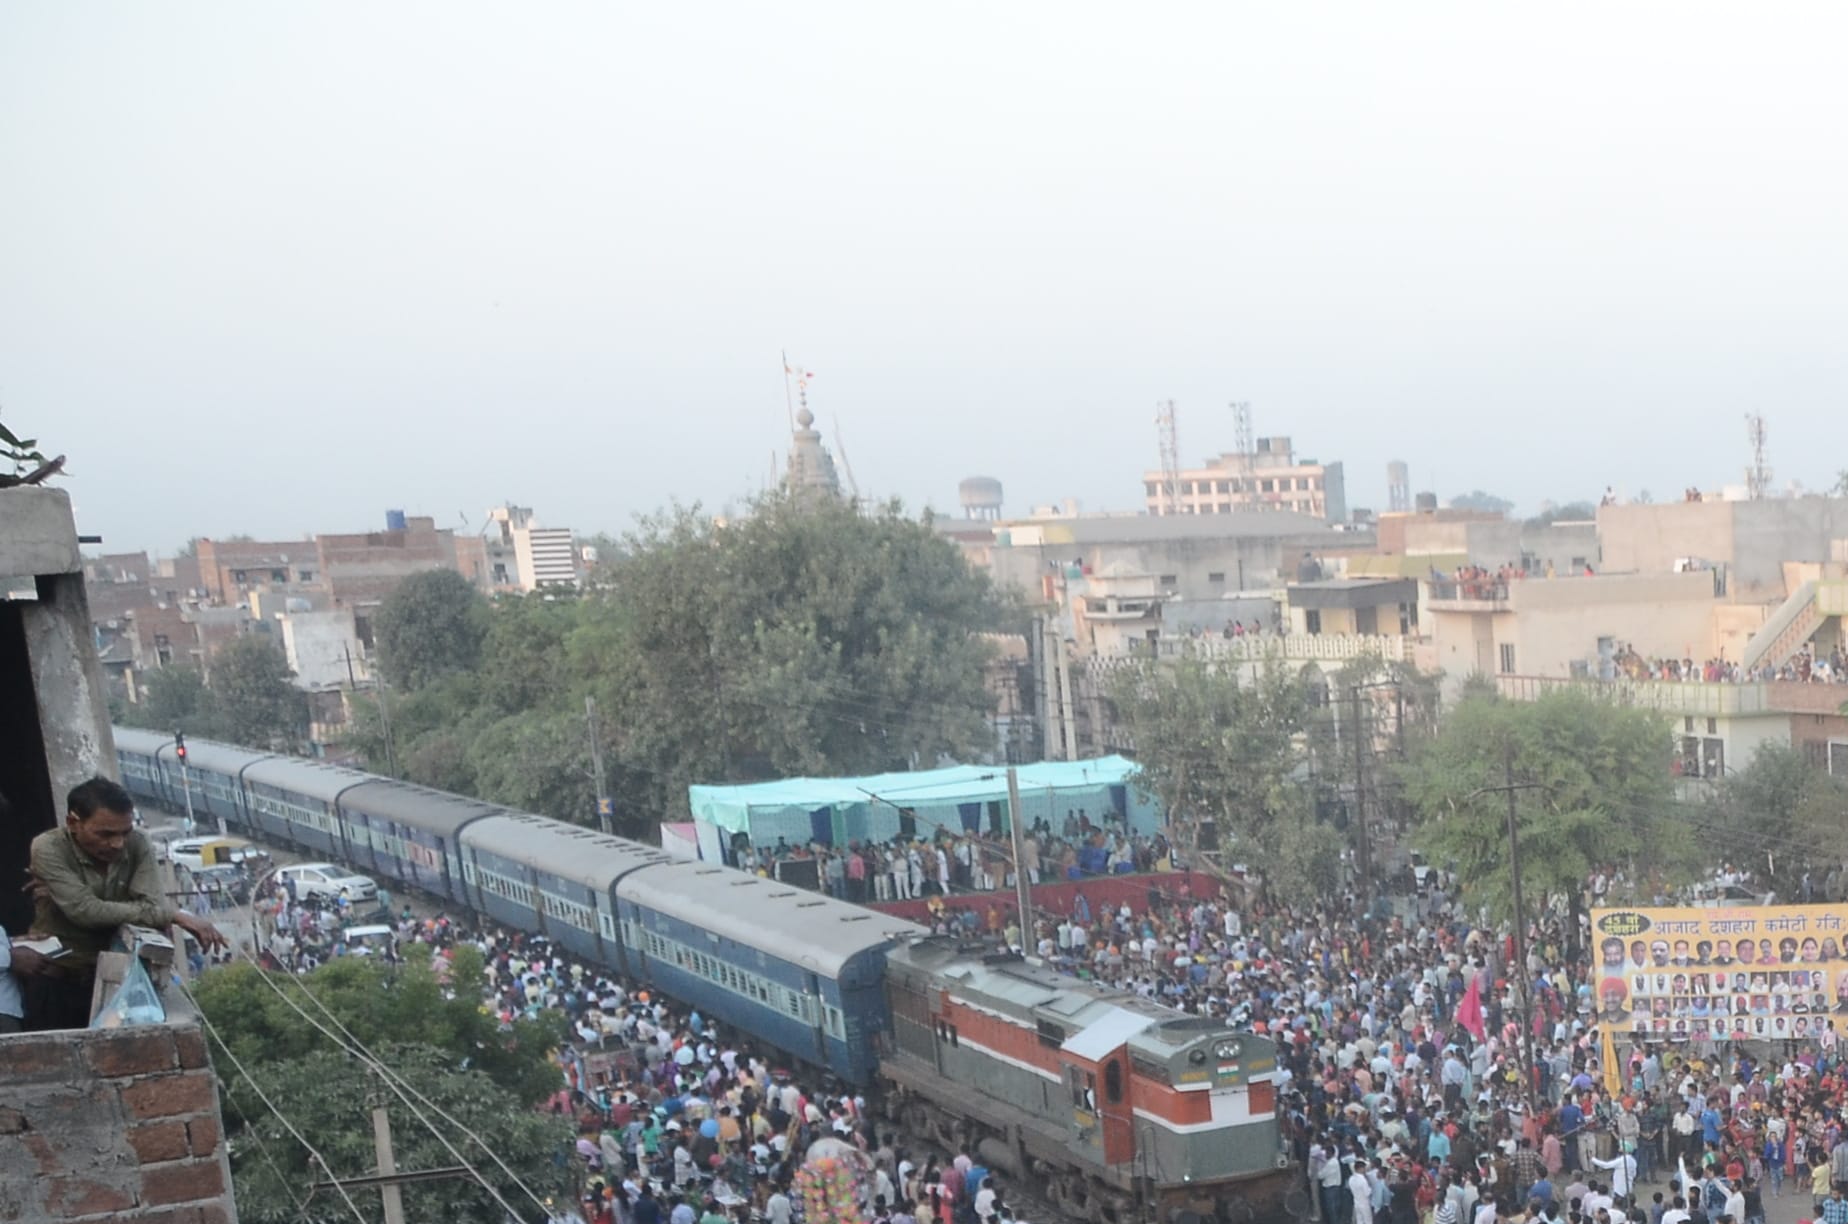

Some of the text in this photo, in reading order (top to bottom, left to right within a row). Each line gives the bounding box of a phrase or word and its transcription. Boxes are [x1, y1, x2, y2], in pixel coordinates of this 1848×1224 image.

[1604, 915, 1621, 926] 45
[1654, 920, 1701, 936] आजाद
[1709, 919, 1757, 935] दशहरा
[1764, 914, 1808, 932] कमेटी
